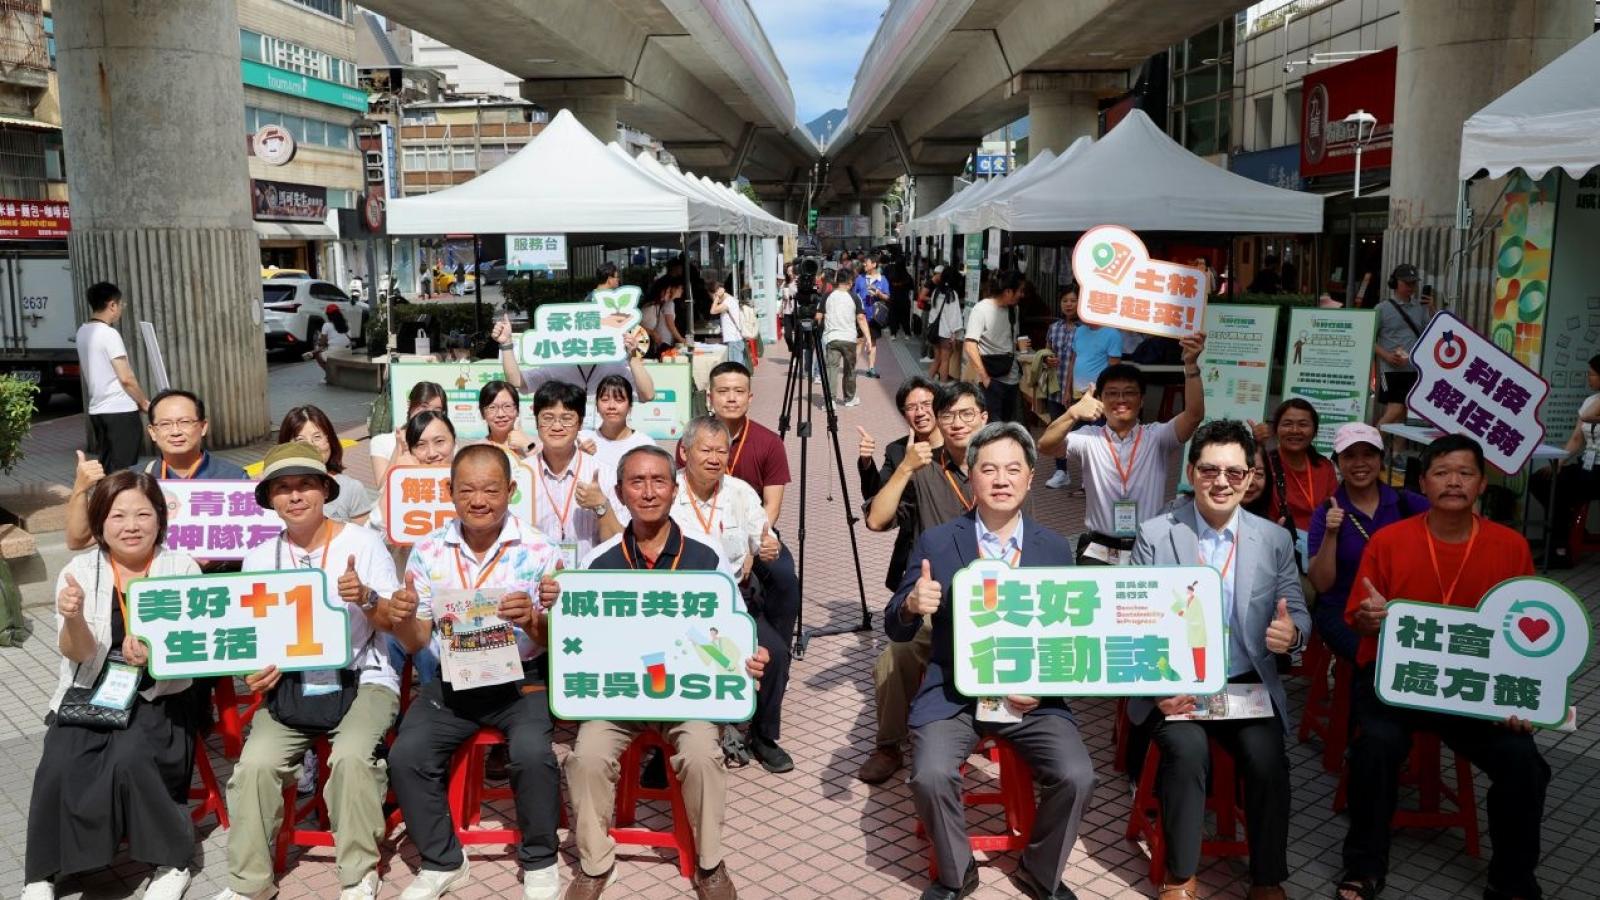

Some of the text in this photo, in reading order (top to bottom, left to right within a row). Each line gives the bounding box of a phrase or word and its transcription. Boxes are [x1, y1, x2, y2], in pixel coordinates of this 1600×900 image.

[514, 237, 557, 250] 服務台
[1134, 268, 1199, 298] 士林
[546, 311, 602, 332] 永續
[1087, 289, 1195, 330] 學起來!
[533, 336, 617, 359] 小尖兵
[1463, 357, 1532, 416] 科技
[1425, 378, 1526, 458] 解任務
[188, 491, 265, 517] 青銀
[166, 525, 284, 551] 神隊友
[137, 585, 231, 623] 美好
[239, 582, 324, 657] +1
[560, 590, 719, 618] 城市共好
[969, 579, 1102, 628] 共好
[164, 626, 258, 664] 生活
[1396, 615, 1495, 658] 社會
[969, 635, 1182, 685] 行動誌
